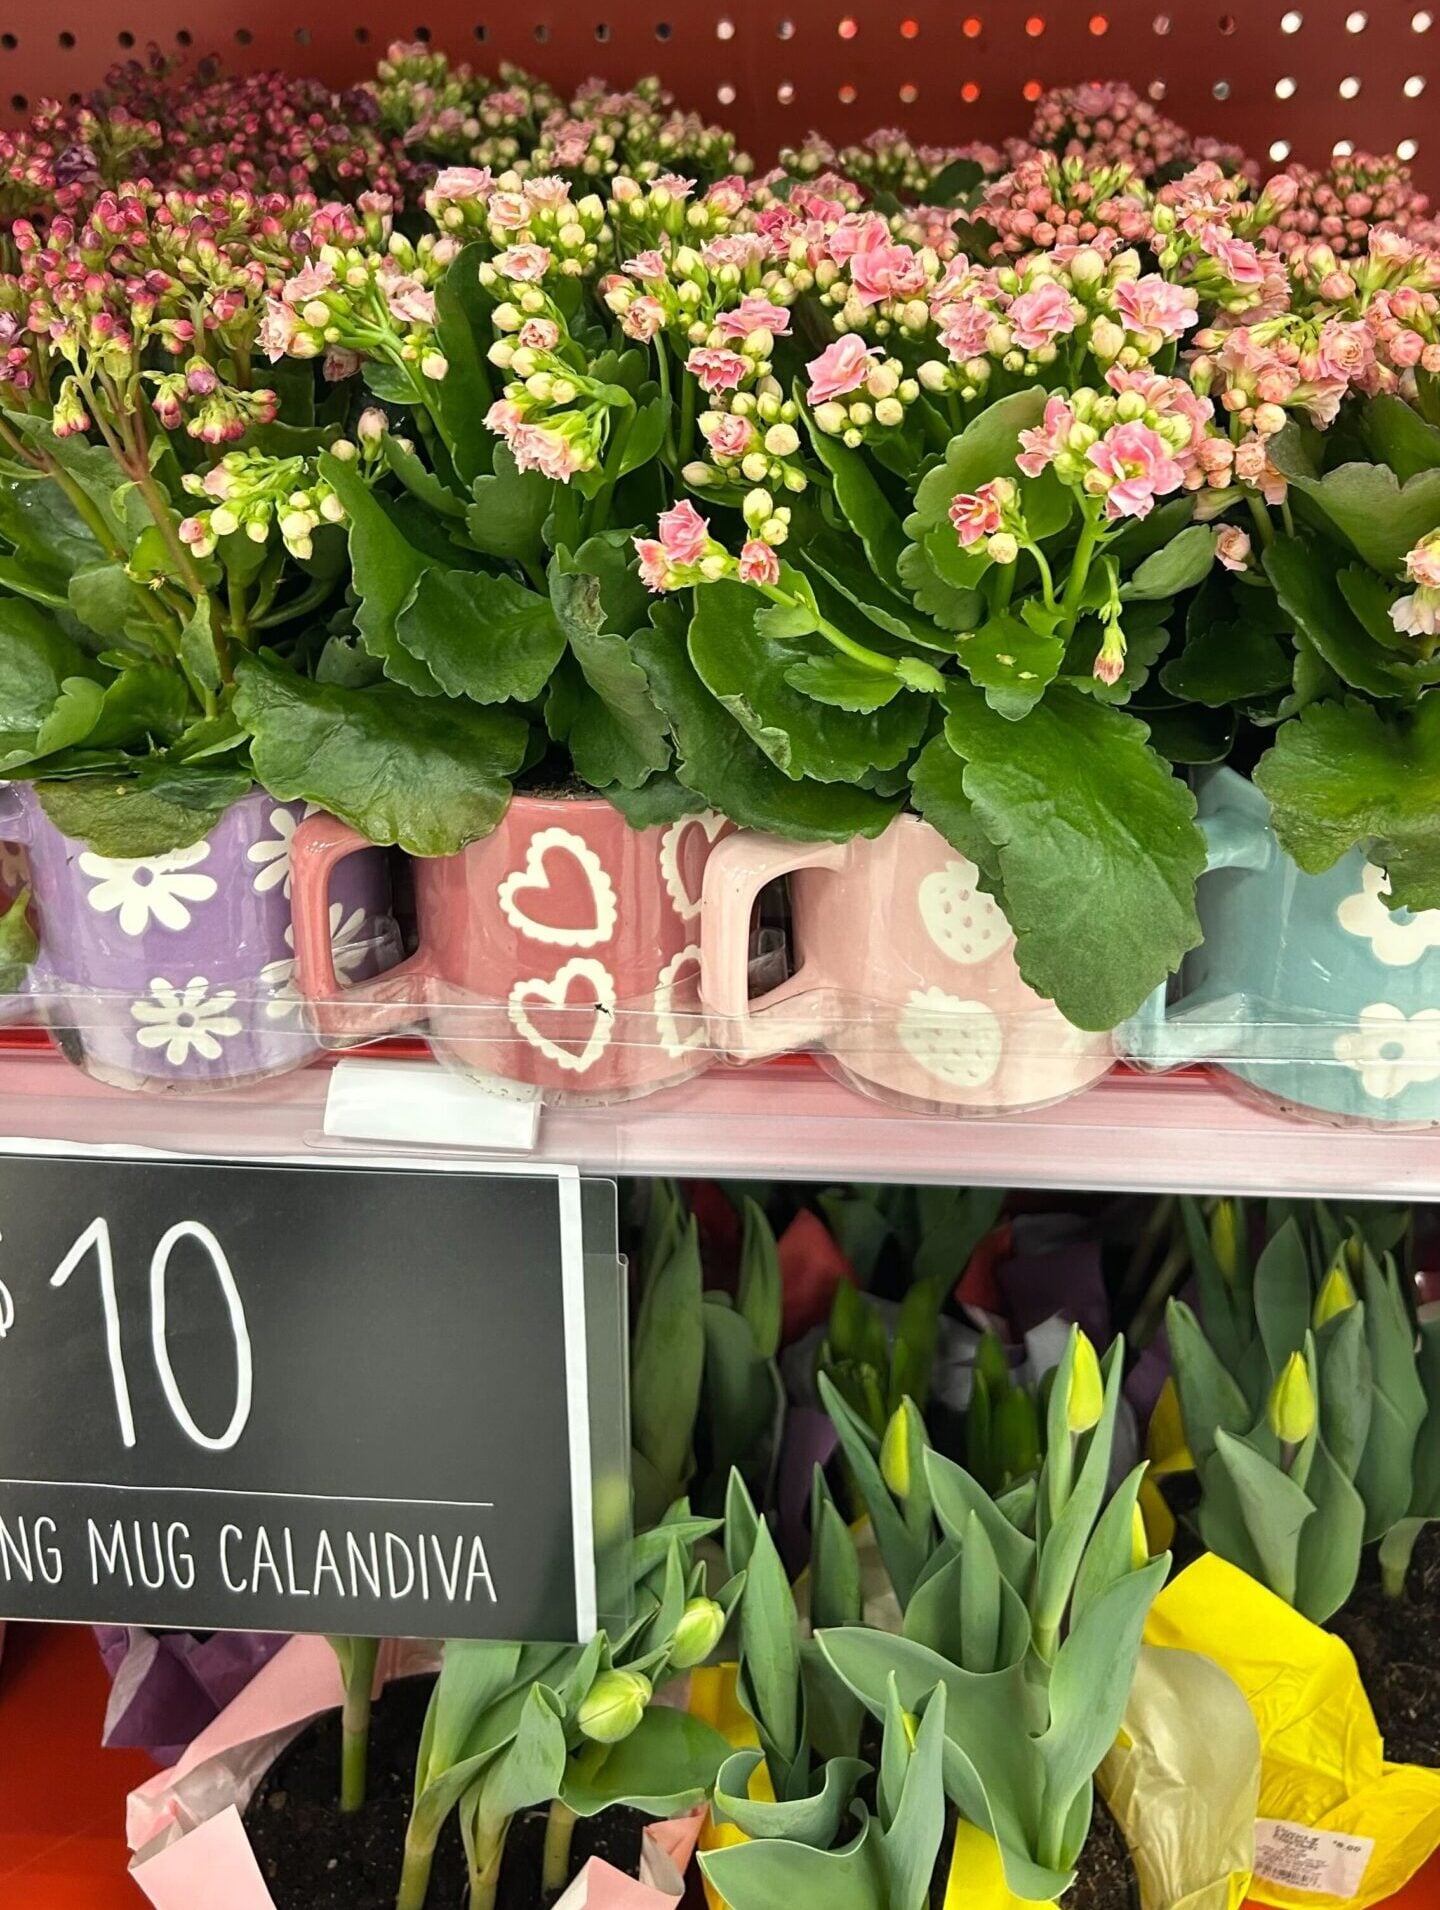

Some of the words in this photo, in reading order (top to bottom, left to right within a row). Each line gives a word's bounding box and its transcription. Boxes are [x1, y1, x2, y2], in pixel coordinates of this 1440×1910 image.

[0, 1515, 62, 1584] NG
[87, 1518, 195, 1590] MUG
[219, 1524, 498, 1602] CALANDIVA
